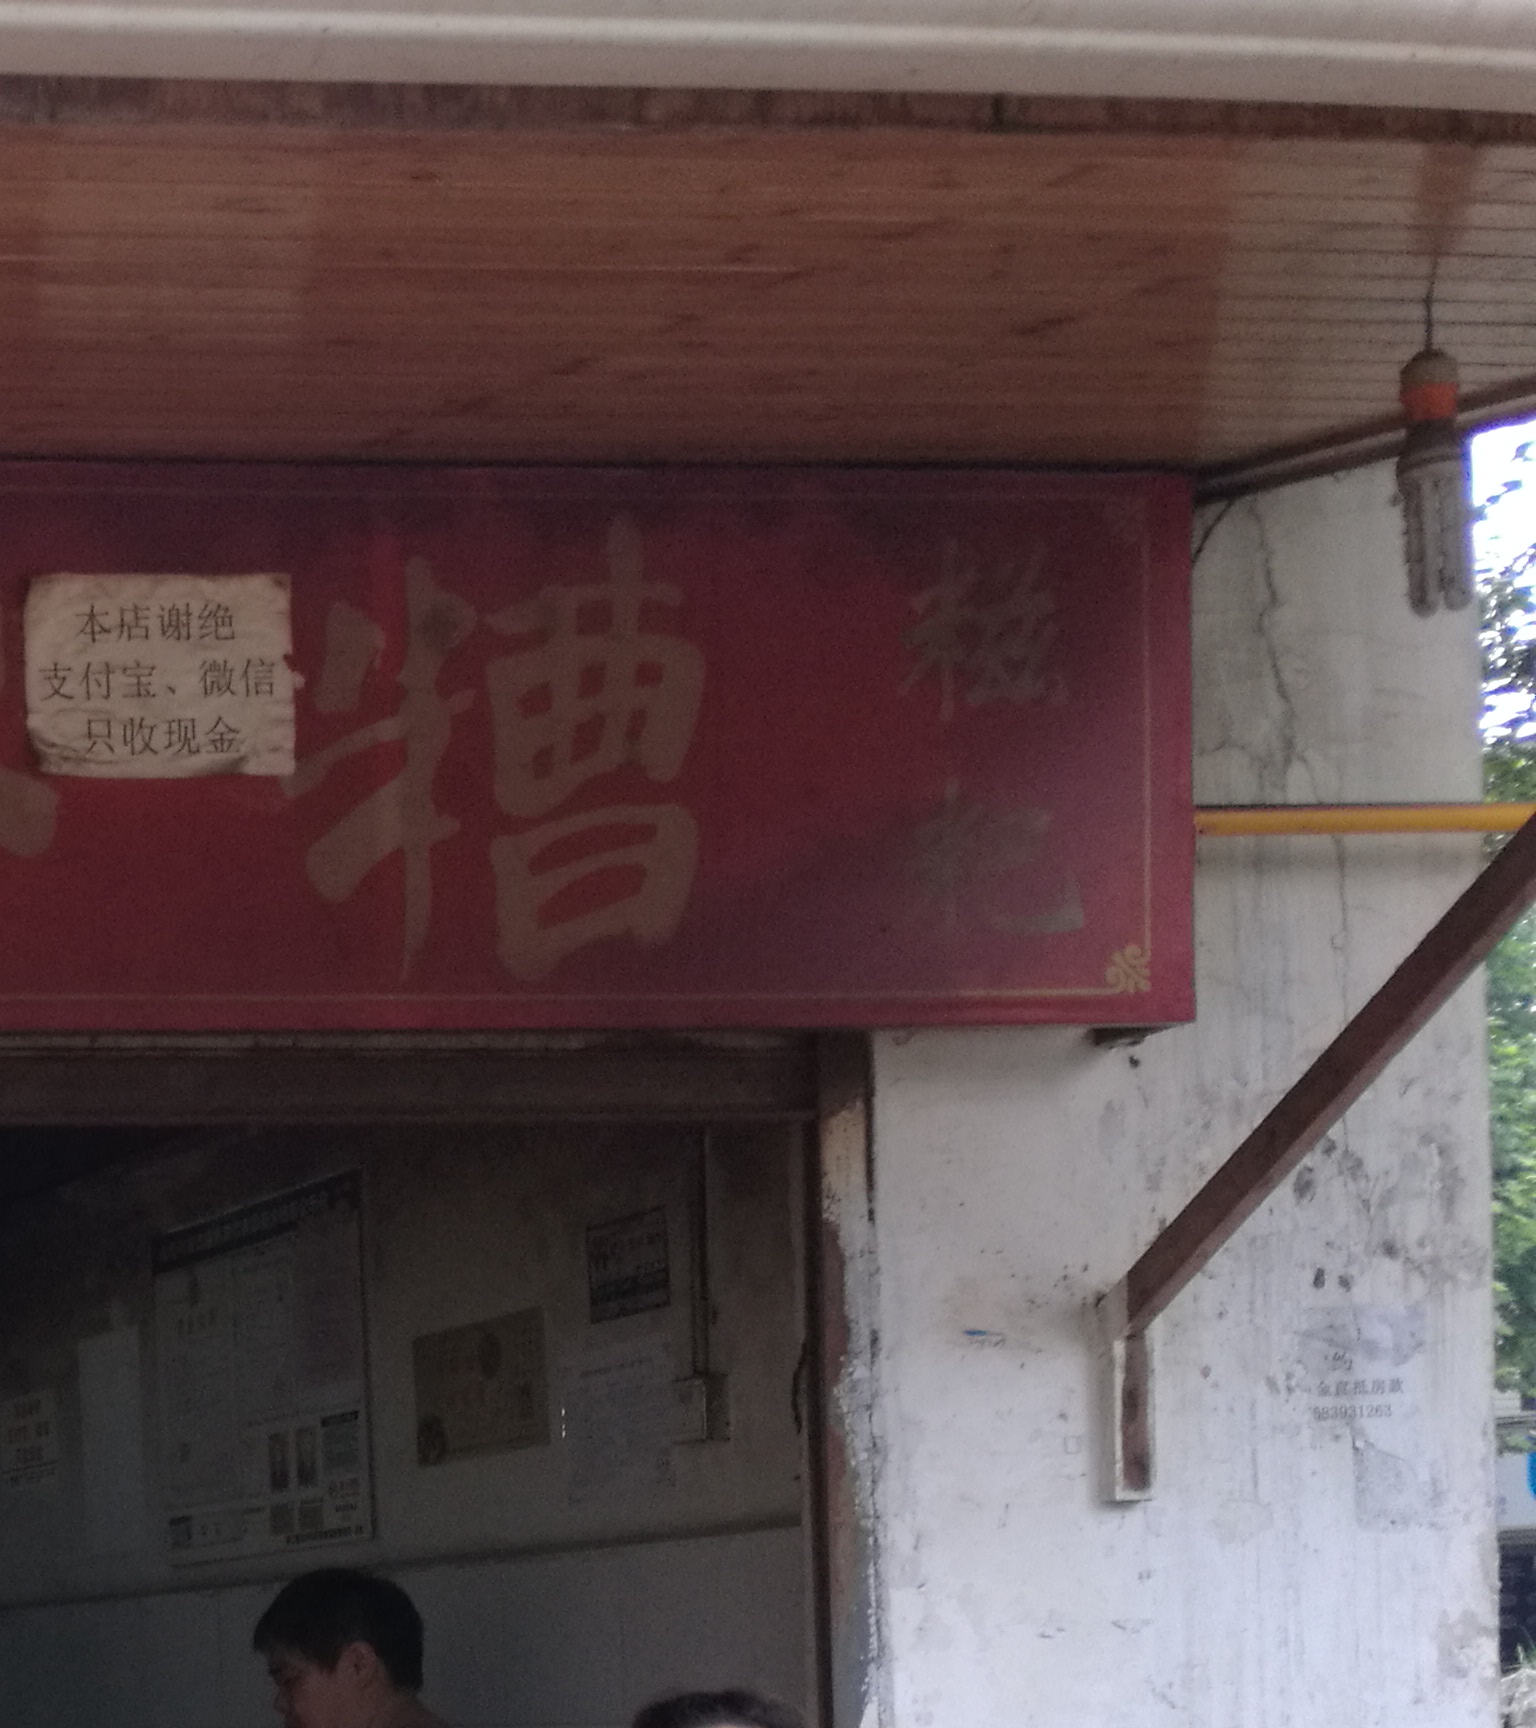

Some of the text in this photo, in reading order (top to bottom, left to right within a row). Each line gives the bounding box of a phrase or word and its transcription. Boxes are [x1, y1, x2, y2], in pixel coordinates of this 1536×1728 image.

[75, 602, 236, 643] 本店谢绝
[38, 658, 275, 701] 支付宝、微信
[85, 715, 242, 757] 只收现金
